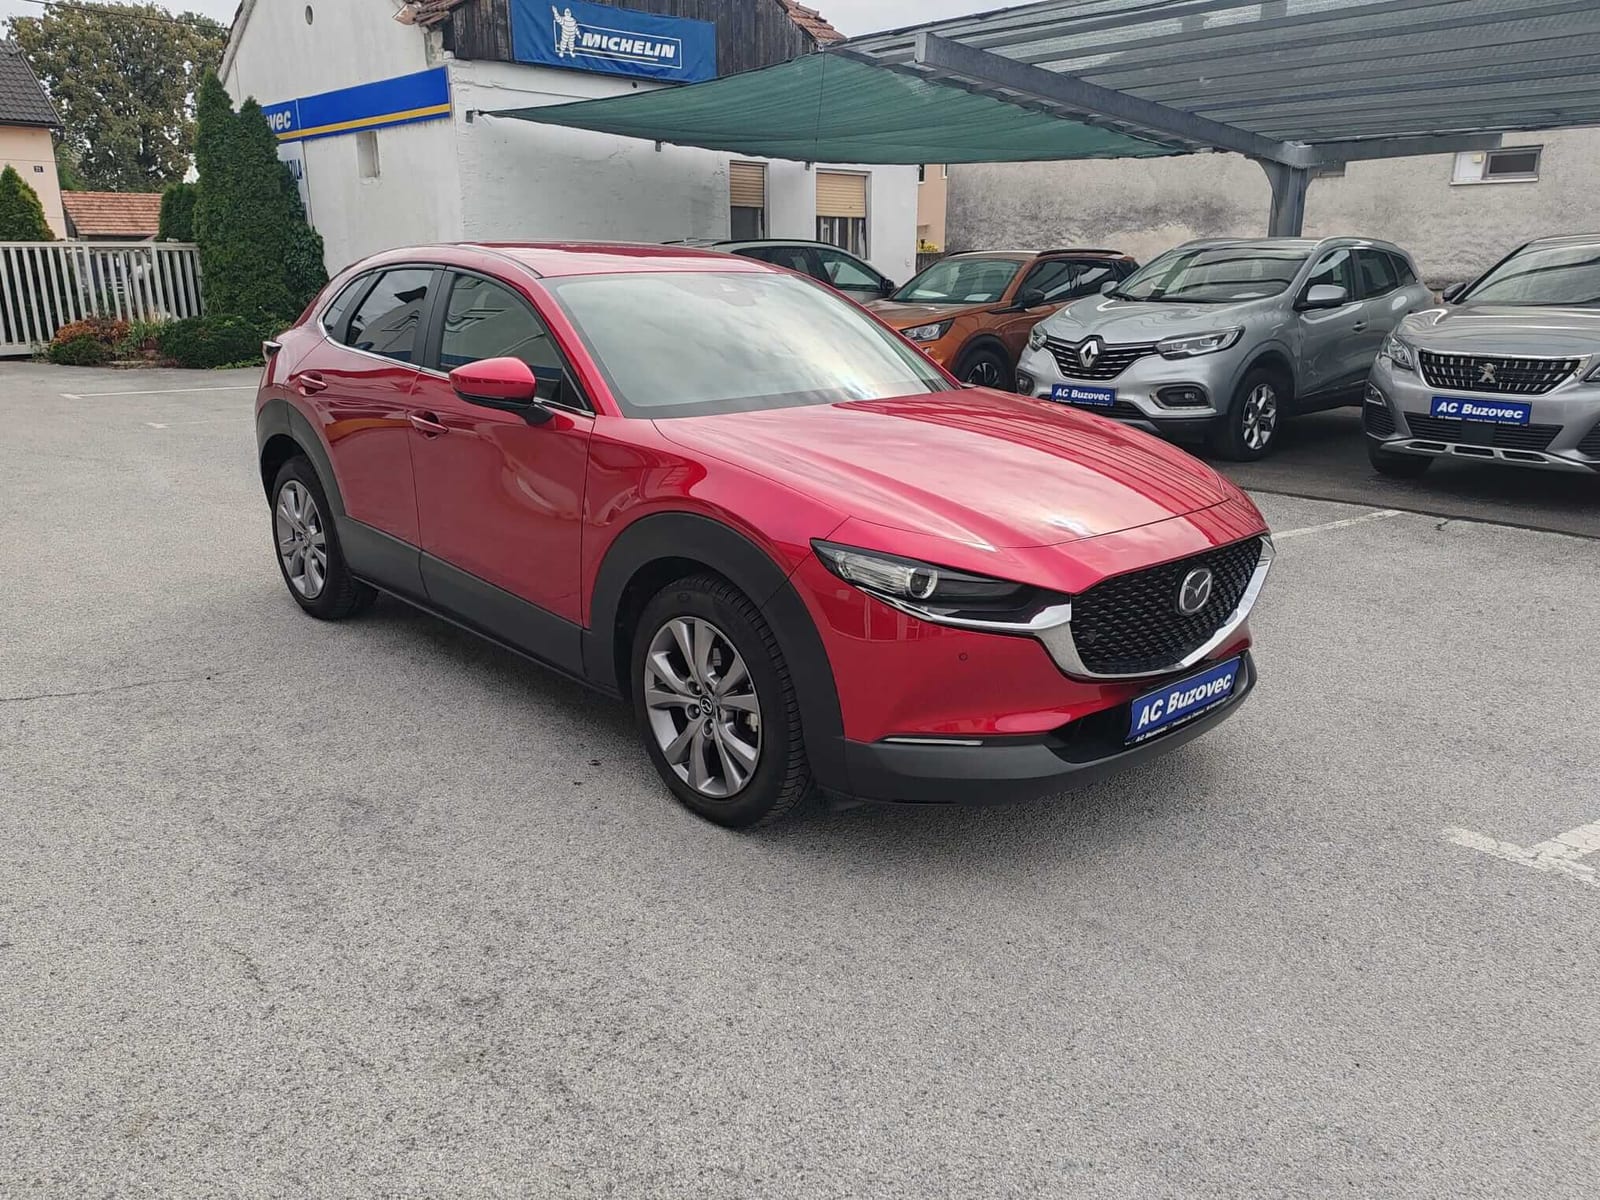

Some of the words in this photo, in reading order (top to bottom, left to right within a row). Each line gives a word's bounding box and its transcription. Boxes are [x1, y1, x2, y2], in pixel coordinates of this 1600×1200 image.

[581, 33, 675, 58] MICHELIN
[266, 110, 292, 130] vec
[1055, 388, 1069, 397] AC
[1071, 390, 1110, 401] Buzovec
[1437, 402, 1458, 413] AC
[1461, 404, 1523, 419] Buzovec
[1137, 699, 1164, 730] AC
[1166, 674, 1231, 715] Buzovec
